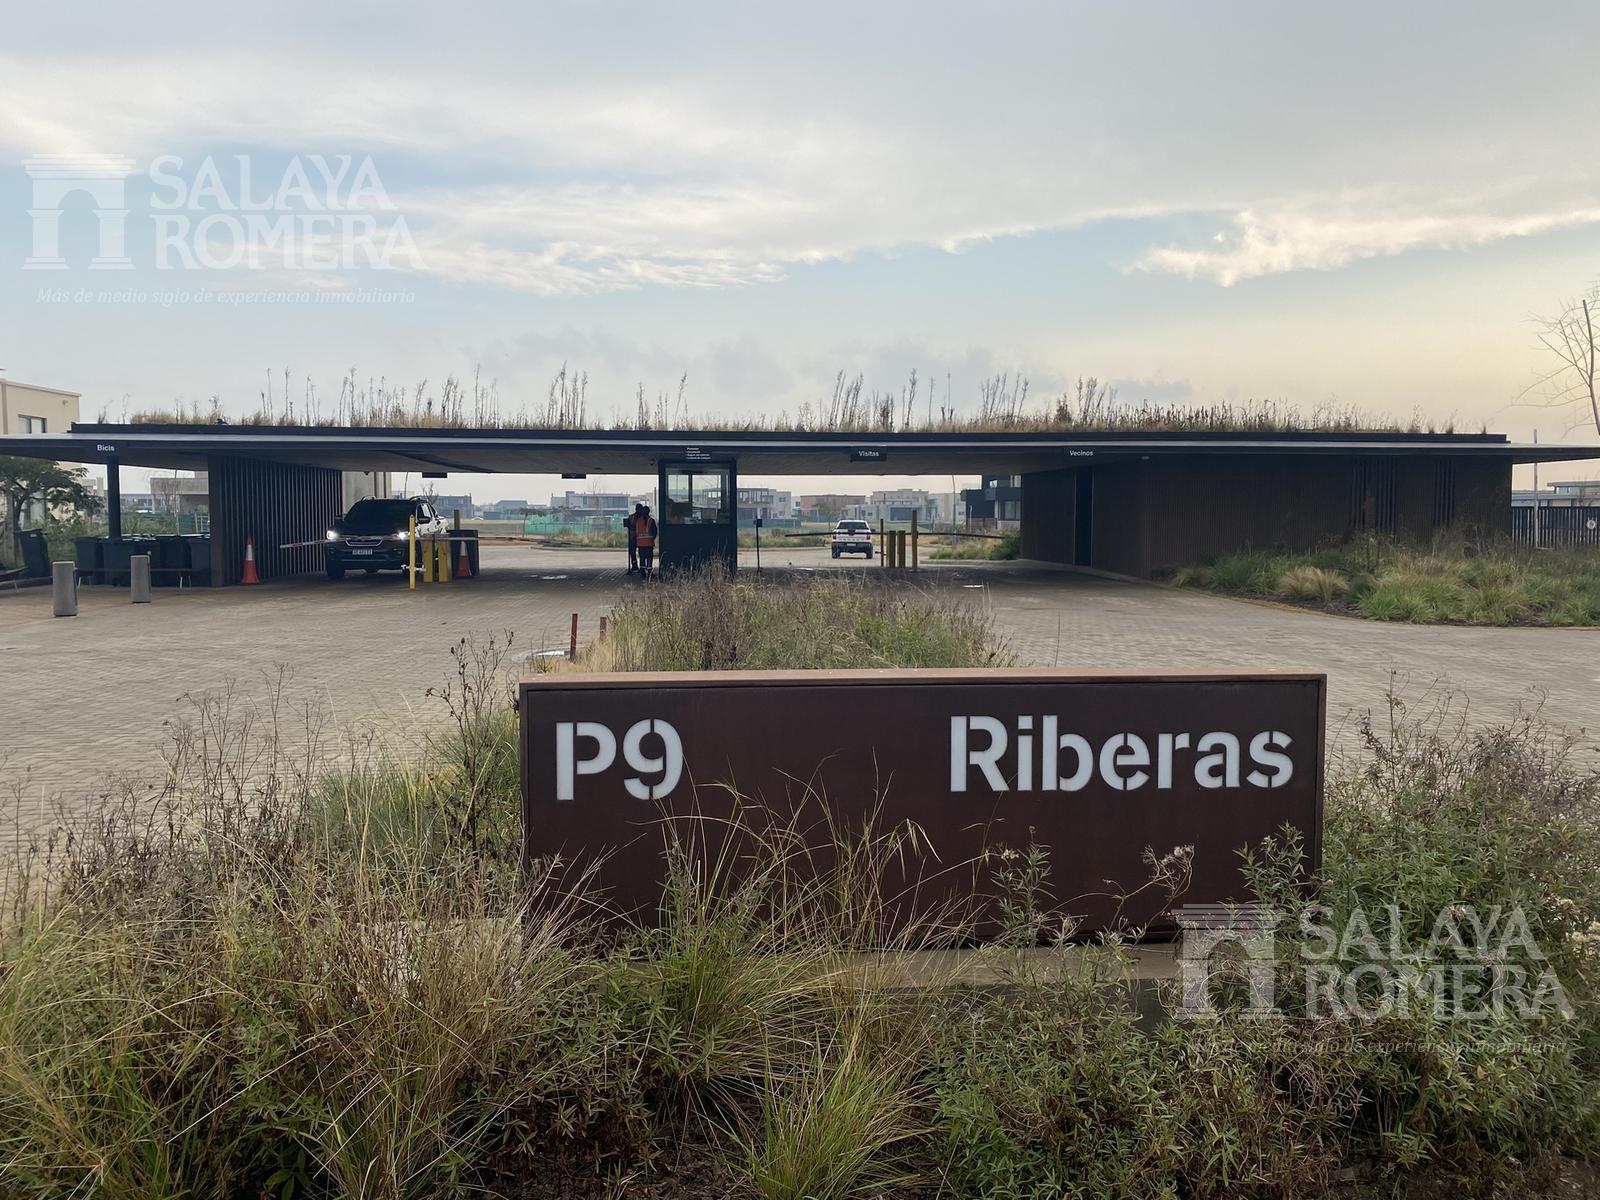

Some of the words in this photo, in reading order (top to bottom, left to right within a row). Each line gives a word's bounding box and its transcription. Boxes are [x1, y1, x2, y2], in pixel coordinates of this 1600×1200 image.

[97, 444, 115, 452] Bicis
[555, 718, 684, 801] P9
[950, 714, 1294, 793] Riberas
